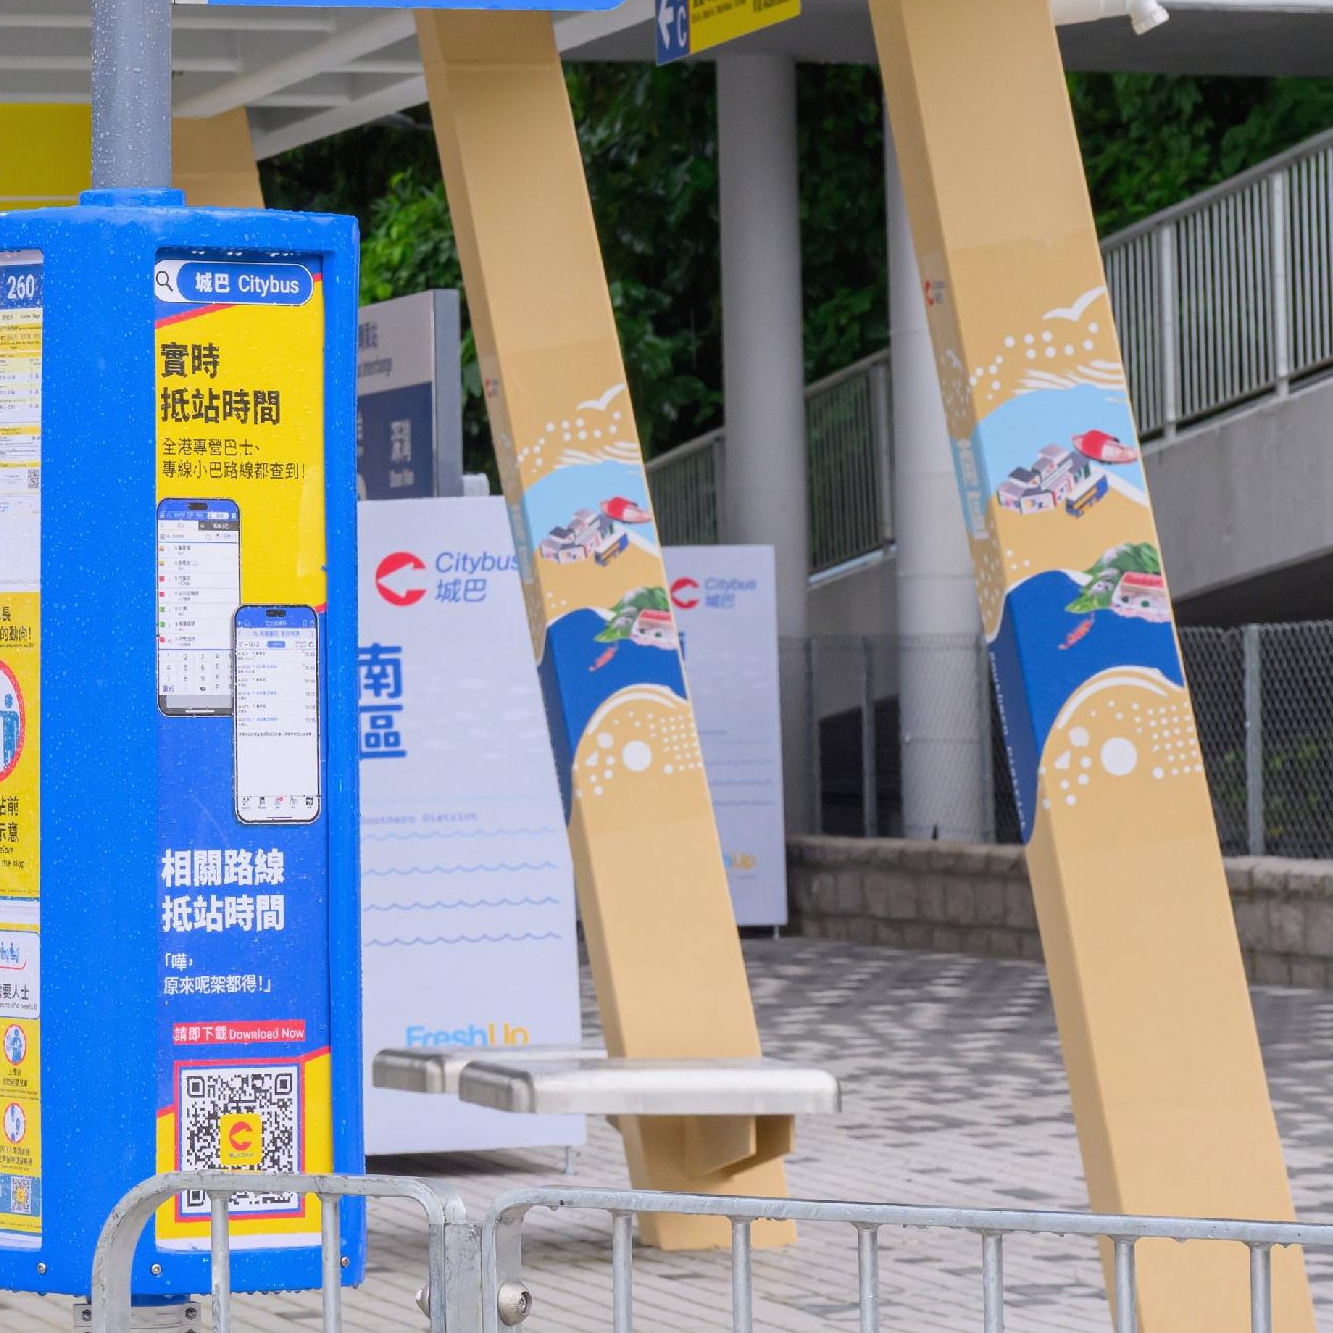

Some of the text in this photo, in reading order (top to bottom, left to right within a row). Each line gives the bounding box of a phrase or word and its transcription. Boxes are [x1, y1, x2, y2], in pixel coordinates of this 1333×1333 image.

[7, 273, 35, 300] 260
[195, 272, 300, 298] 城巴 Citybus
[160, 342, 220, 379] 實時
[160, 387, 281, 426] 抵站時間
[162, 460, 306, 480] 專線小巴路線都查到！
[434, 551, 519, 575] Citybus
[434, 578, 488, 603] 城巴
[358, 642, 407, 758] 南區
[161, 848, 285, 888] 相關路線
[161, 893, 285, 933] 抵站時間
[173, 1025, 305, 1043] 請即下載 Download Now
